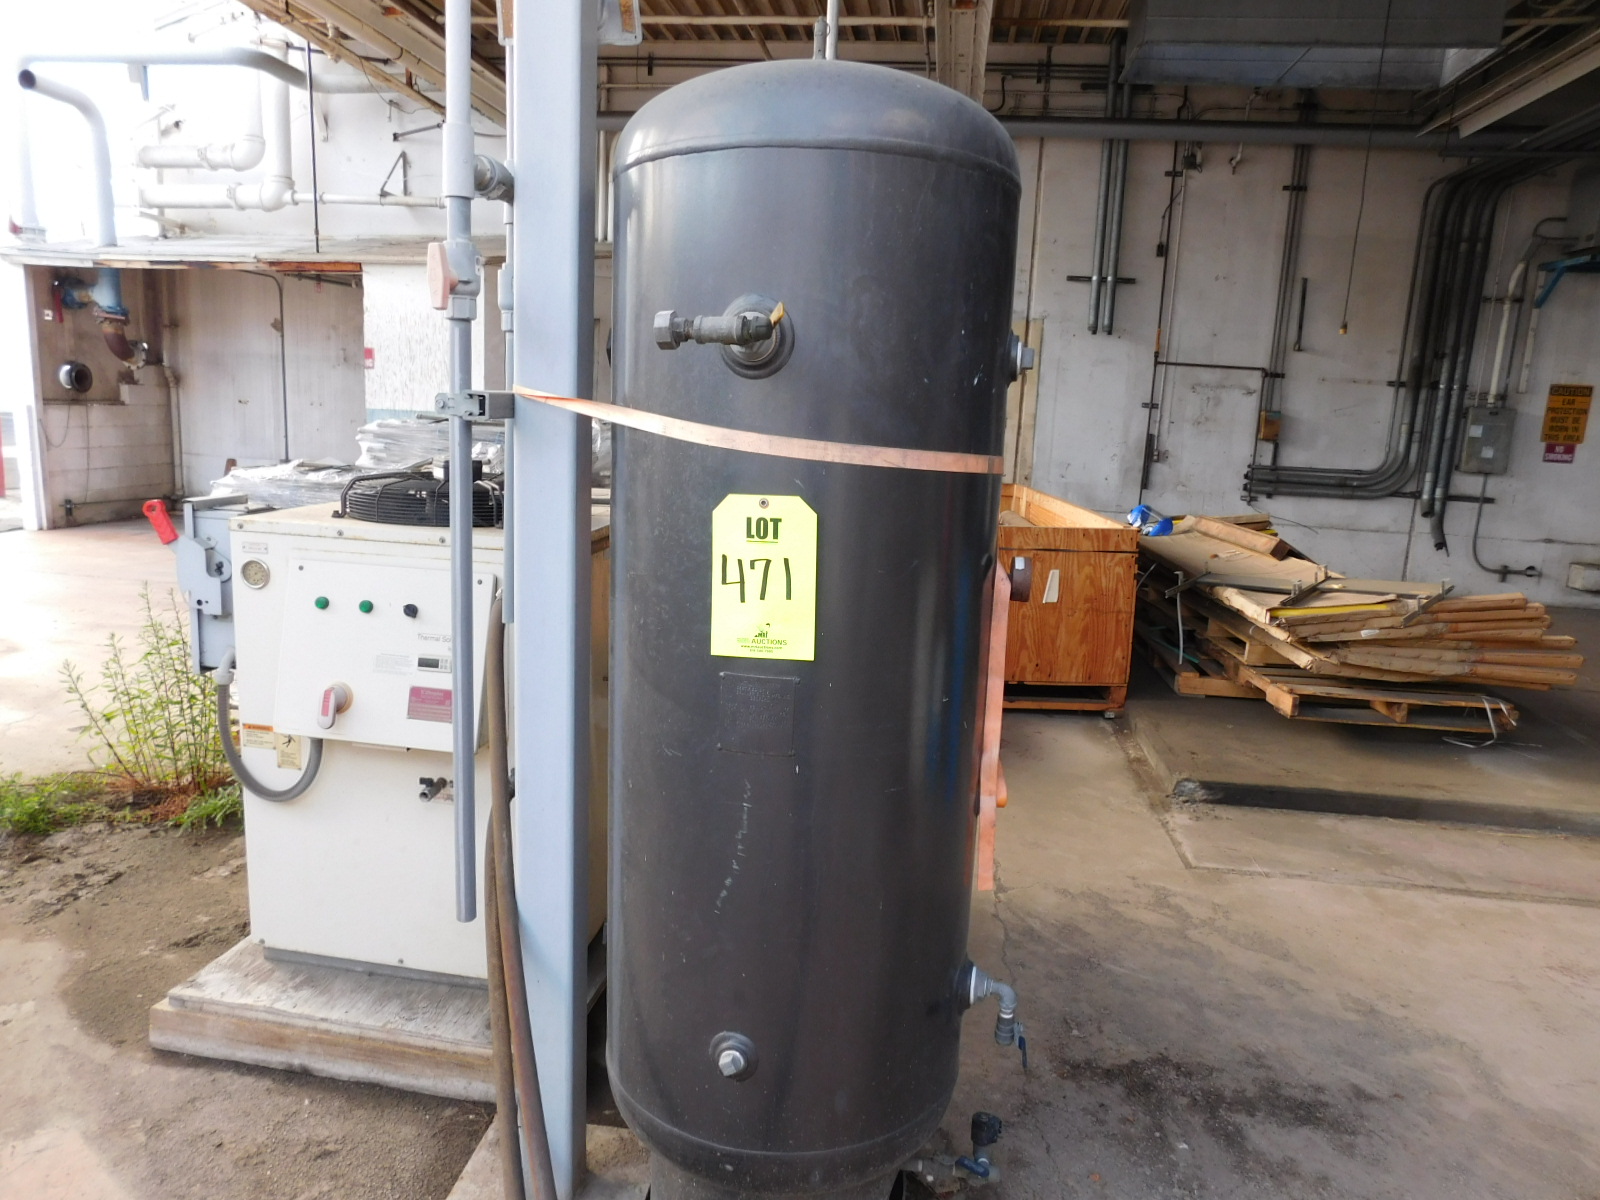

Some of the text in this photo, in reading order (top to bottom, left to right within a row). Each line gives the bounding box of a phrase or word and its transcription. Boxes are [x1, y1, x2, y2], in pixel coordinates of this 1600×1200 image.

[1551, 387, 1590, 395] CAUTION
[1546, 407, 1588, 415] PROTECTION
[1550, 416, 1569, 424] MUST
[1545, 453, 1573, 461] SMOKING
[746, 516, 782, 540] LOT
[721, 553, 792, 603] 471
[417, 632, 441, 642] Thermal
